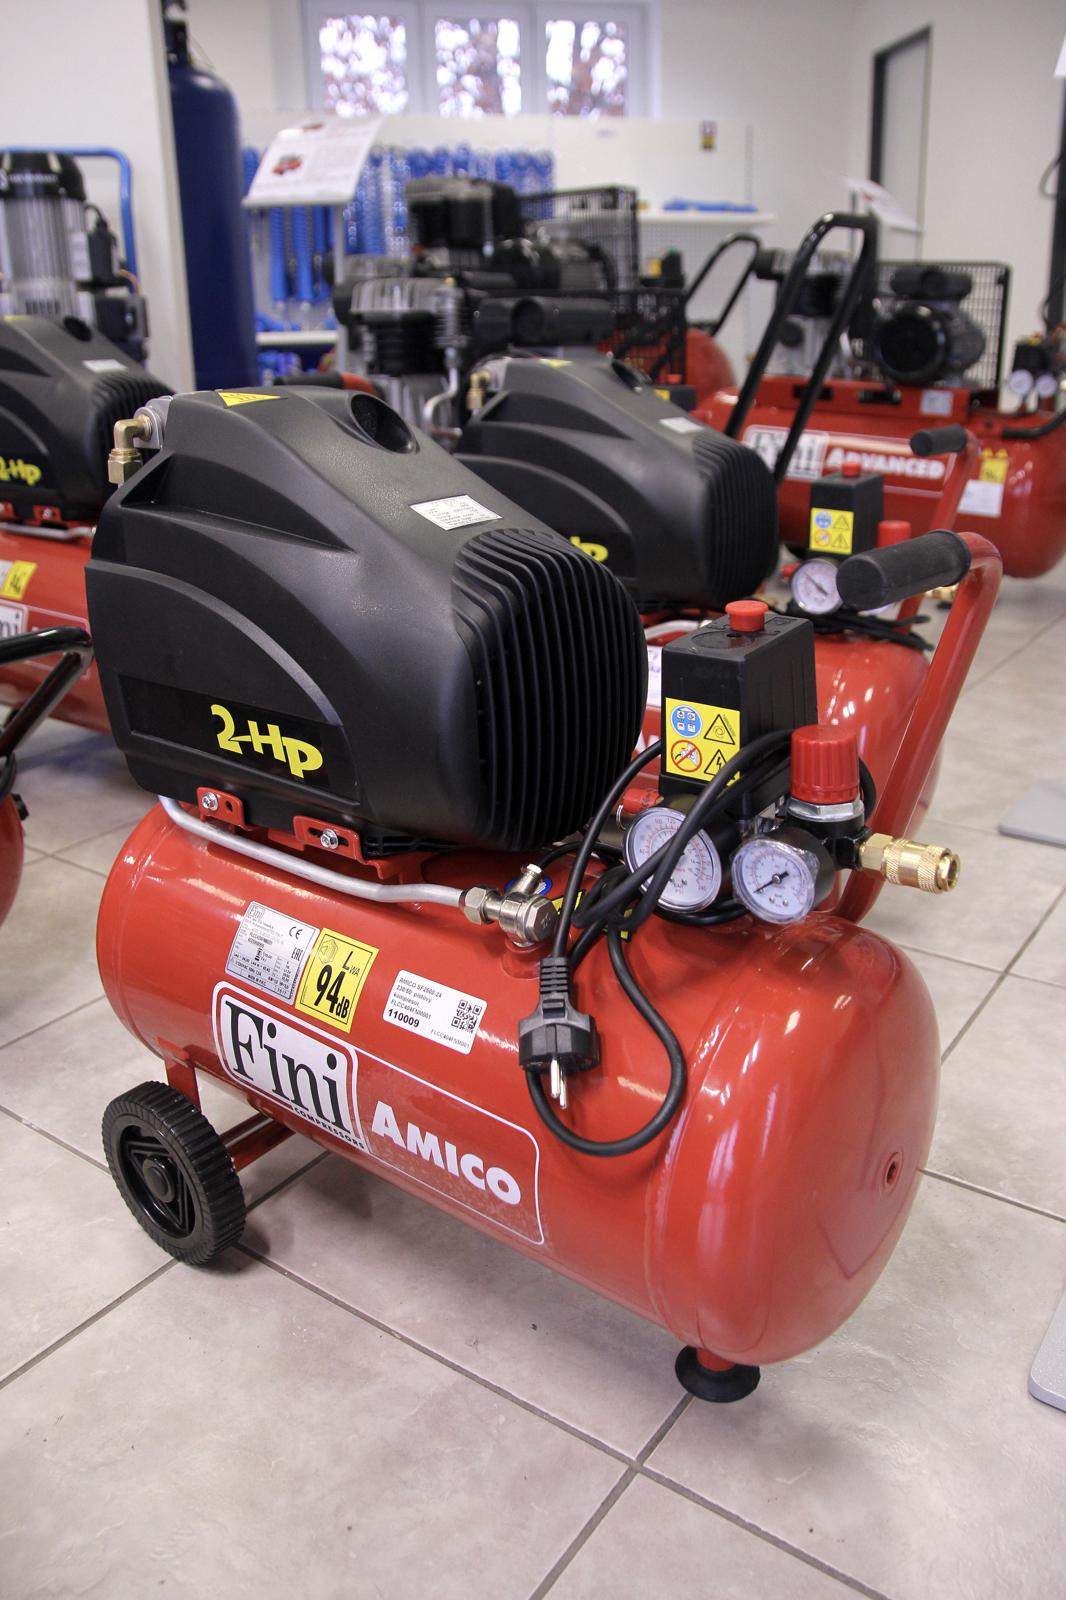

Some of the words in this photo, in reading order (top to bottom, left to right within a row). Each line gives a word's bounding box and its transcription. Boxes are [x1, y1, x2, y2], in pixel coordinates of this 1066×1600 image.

[827, 447, 946, 480] ADVANCED
[399, 977, 416, 988] AMICO
[388, 1008, 420, 1028] 110009
[225, 1000, 350, 1133] Fini
[292, 1106, 365, 1149] COMPRESSORS
[371, 1100, 522, 1205] AMICO
